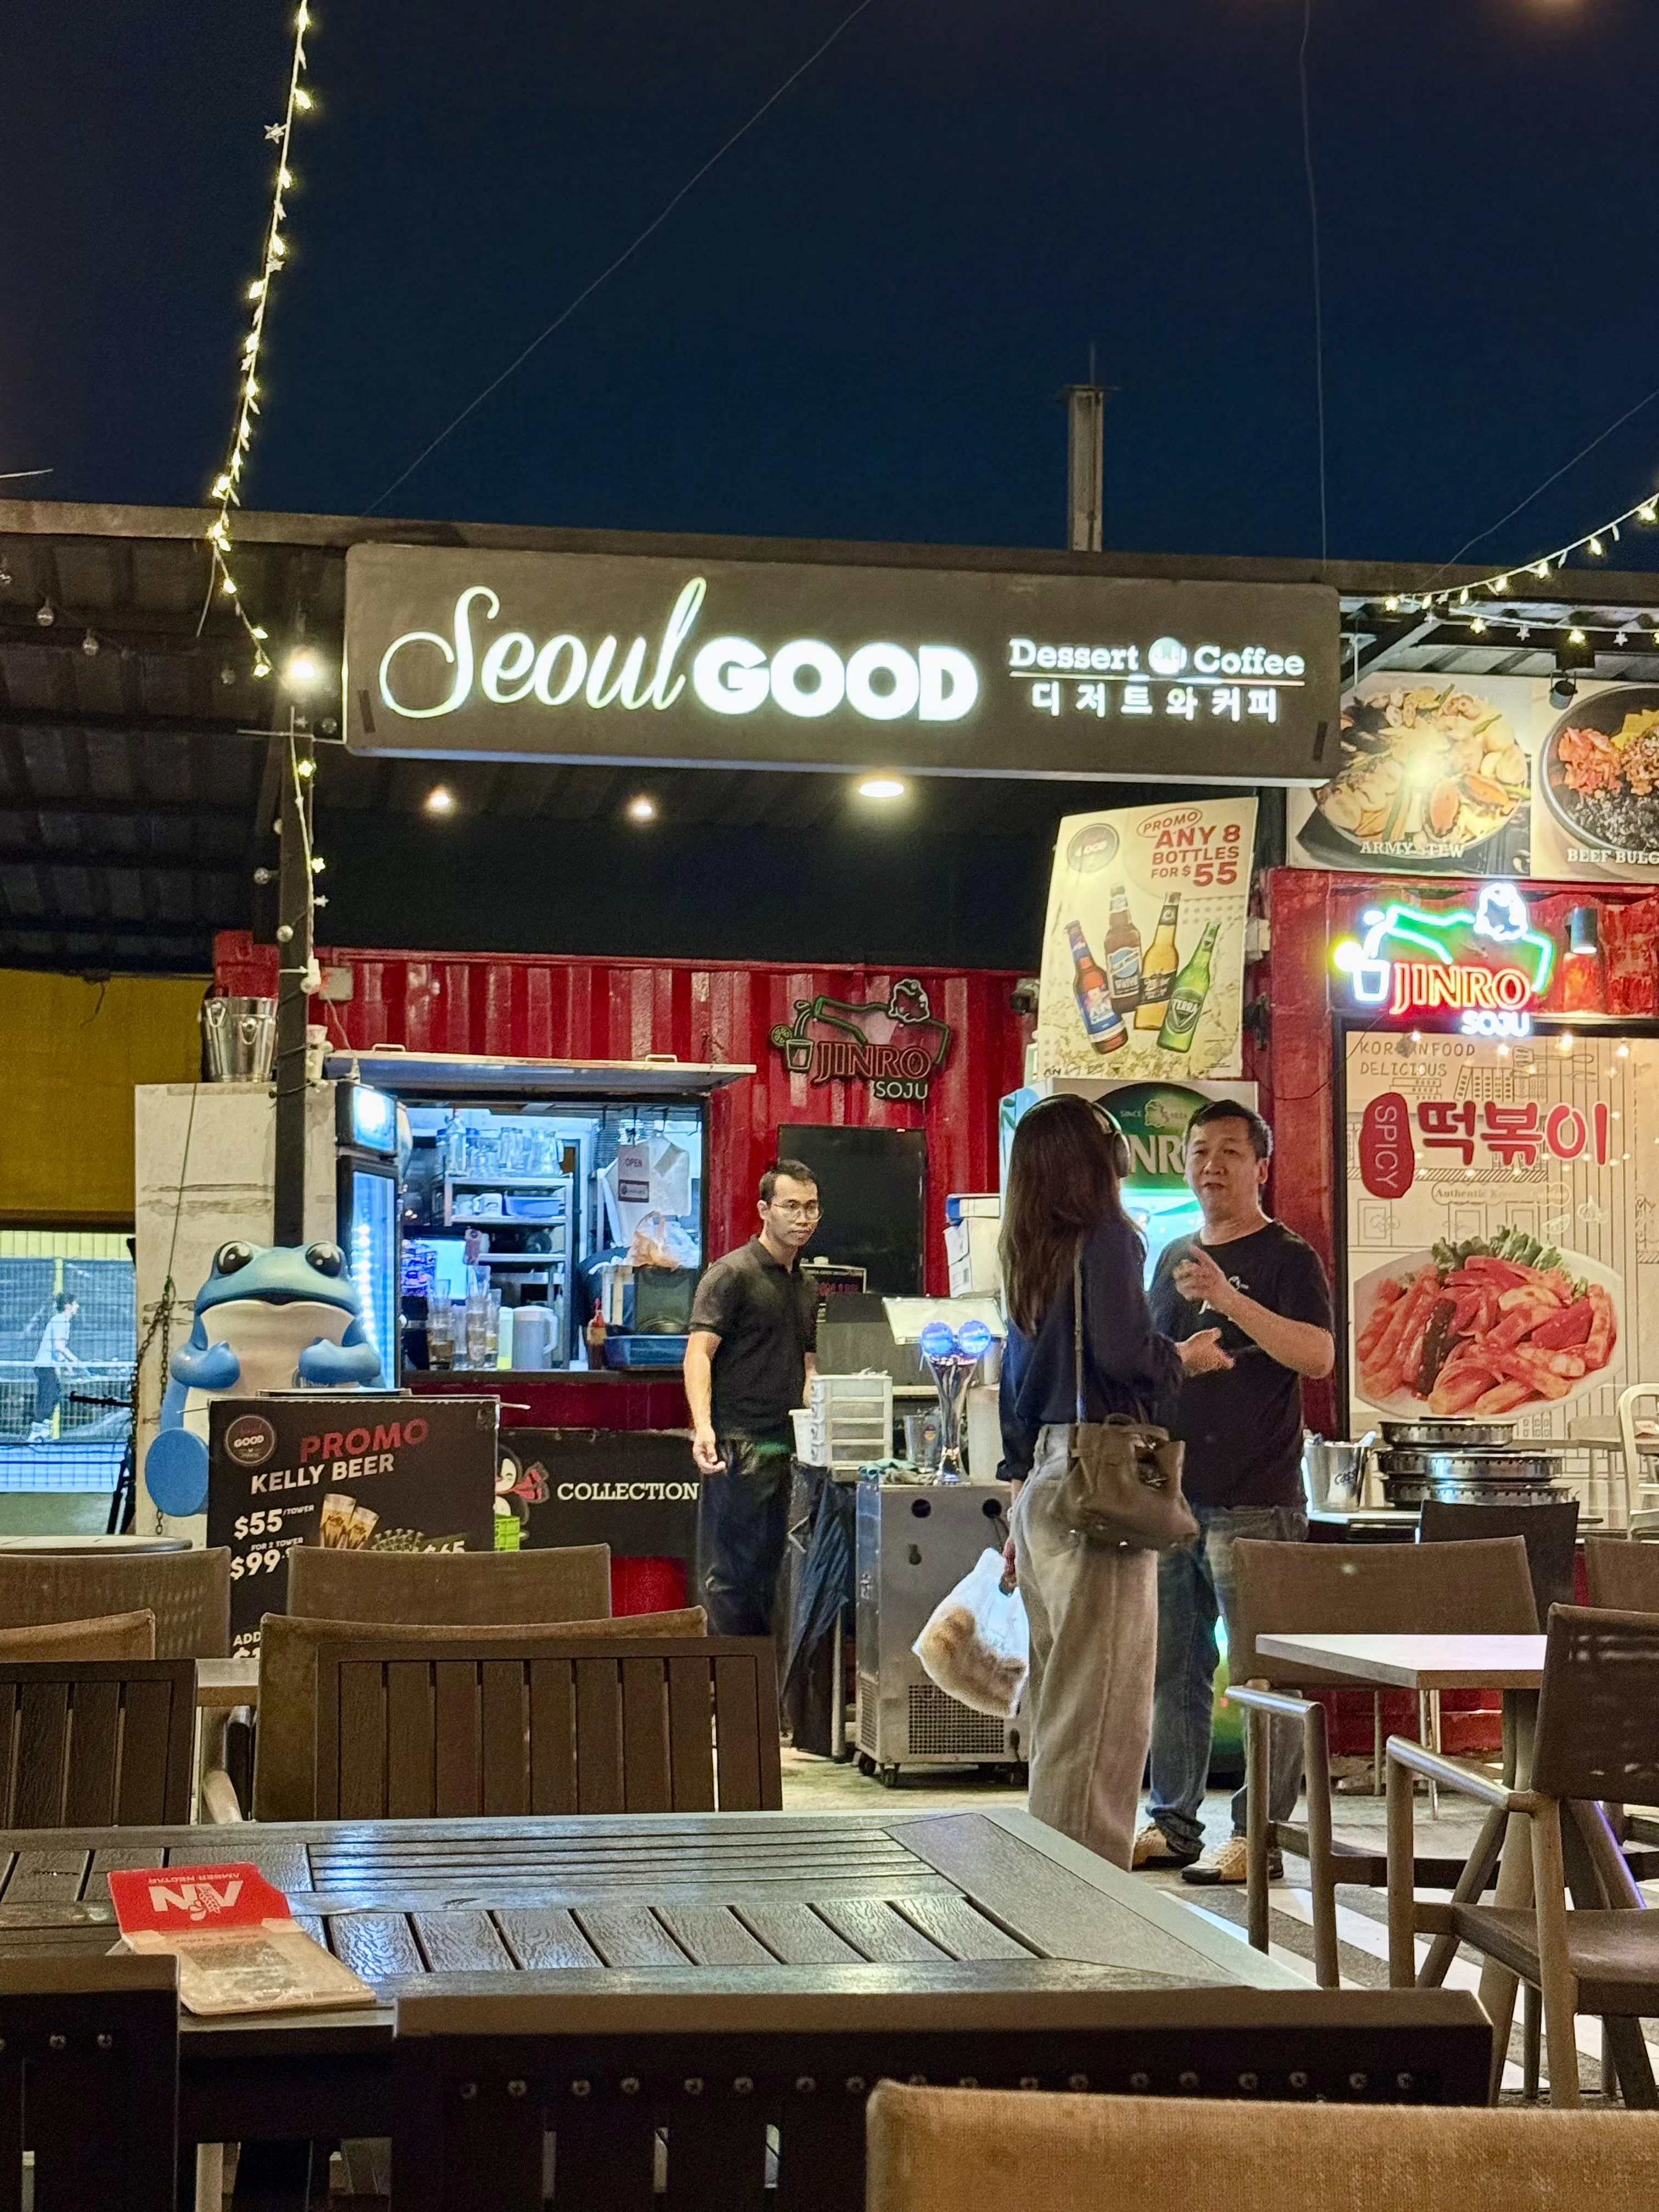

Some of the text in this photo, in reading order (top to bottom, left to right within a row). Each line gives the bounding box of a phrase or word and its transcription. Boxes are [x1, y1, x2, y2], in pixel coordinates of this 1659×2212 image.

[379, 577, 978, 721] Seoul GOOD
[1009, 638, 1305, 676] Dessert Coffee
[1143, 811, 1198, 834] PROMO
[1154, 824, 1240, 849] ANY 8
[1152, 846, 1239, 865] BOTTLES
[1359, 840, 1465, 857] ARMY STEW
[1567, 848, 1611, 862] BEEF
[1151, 867, 1178, 879] FOR
[1389, 963, 1531, 1015] JINRO
[1461, 1011, 1532, 1036] SOJU
[1360, 1041, 1475, 1056] KORN FOOD
[814, 1042, 932, 1084] JINRO
[1361, 1062, 1447, 1076] DELICIOUS
[876, 1081, 929, 1099] SOJU
[1417, 1100, 1610, 1166] 떡볶이
[1374, 1105, 1398, 1189] SPICY
[1435, 1189, 1486, 1198] Authentic
[301, 1418, 428, 1463] PROMO
[251, 1453, 395, 1495] KELLY BEER
[557, 1482, 699, 1500] COLLECTION
[251, 1543, 267, 1551] FOR
[276, 1537, 303, 1547] TOWER
